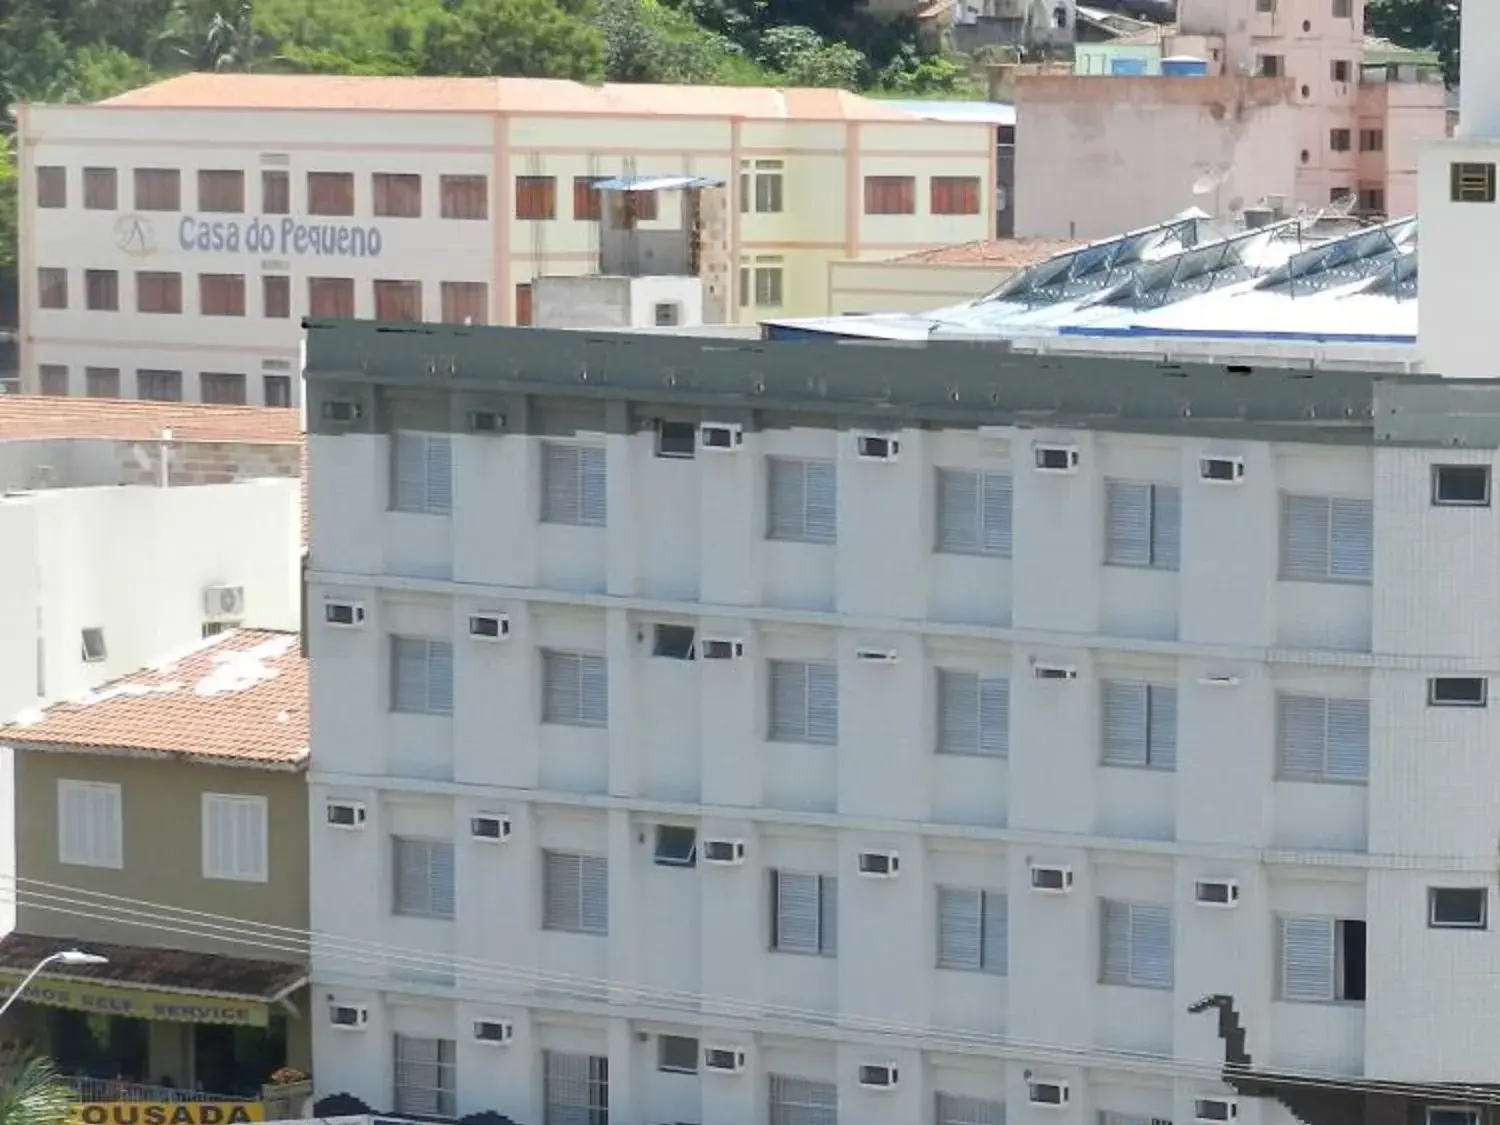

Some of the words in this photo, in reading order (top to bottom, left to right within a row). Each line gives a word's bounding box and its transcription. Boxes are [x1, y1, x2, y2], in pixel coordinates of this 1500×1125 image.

[178, 216, 240, 251] Casa
[245, 217, 275, 253] do
[281, 217, 382, 257] Pequeno
[153, 1003, 248, 1020] SERVICE
[68, 1104, 251, 1125] OUSADA
